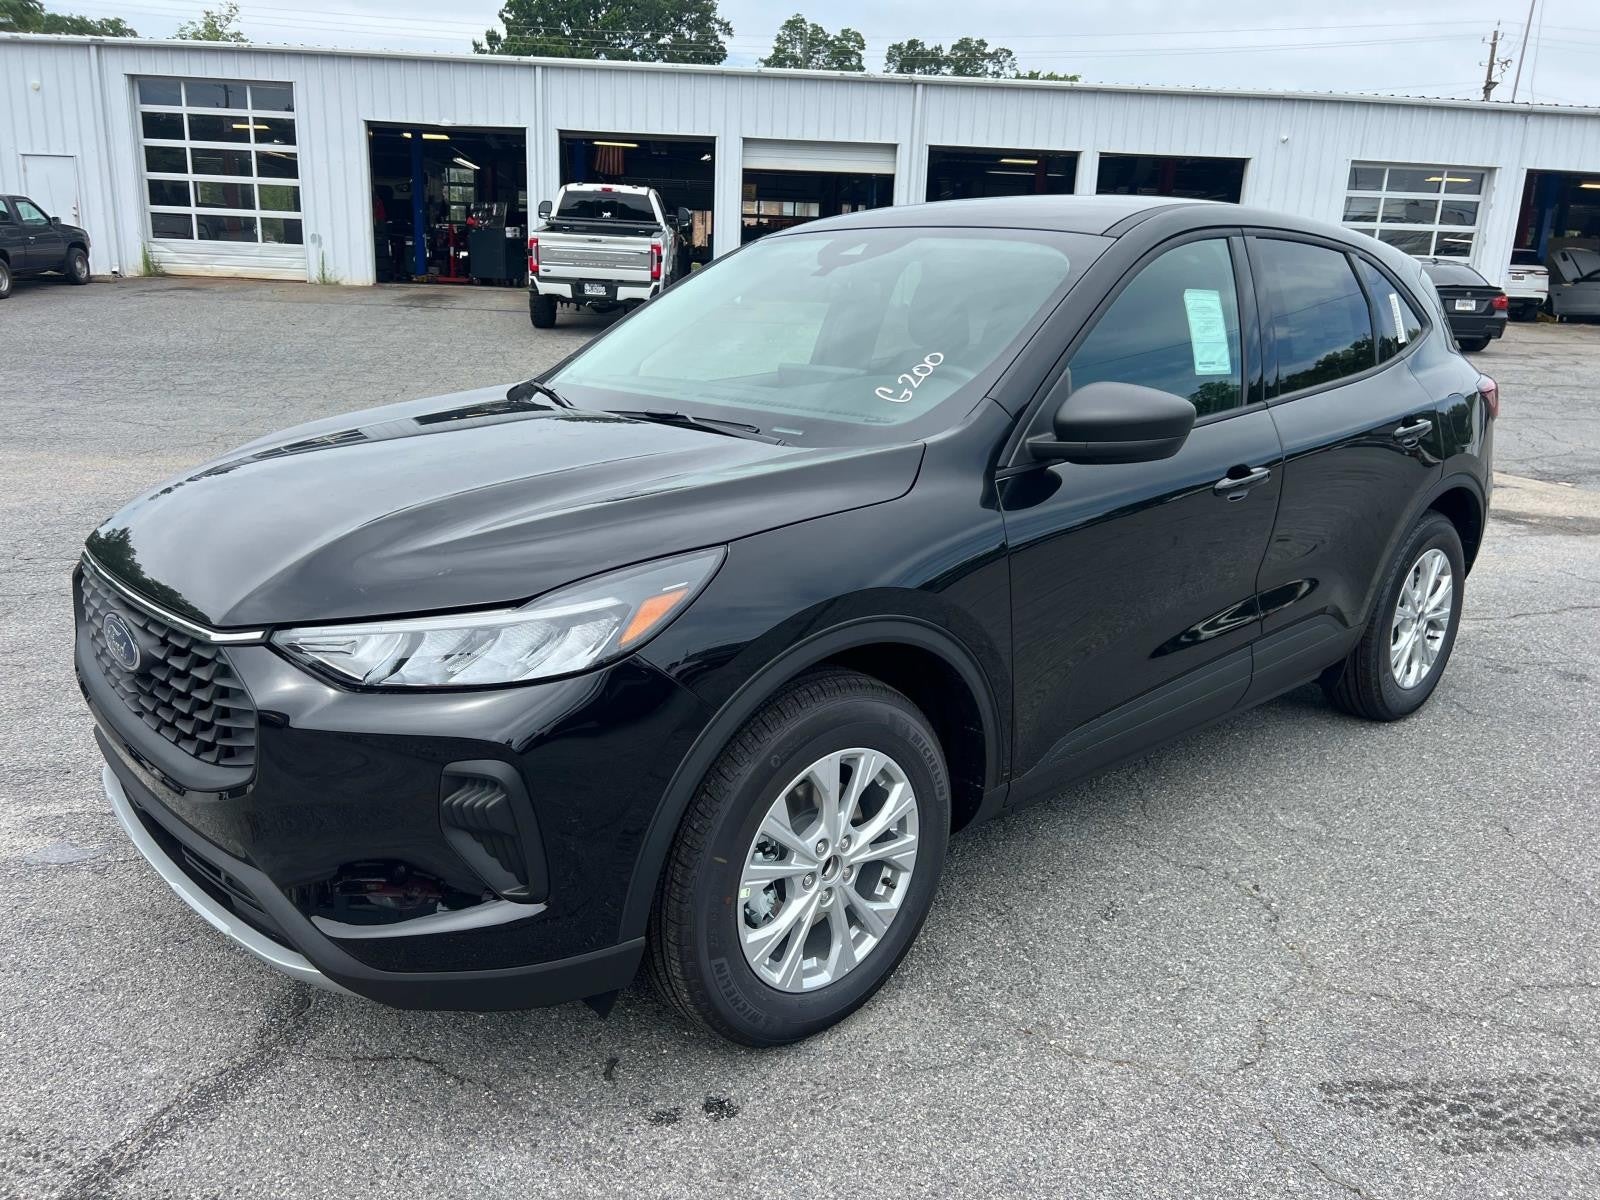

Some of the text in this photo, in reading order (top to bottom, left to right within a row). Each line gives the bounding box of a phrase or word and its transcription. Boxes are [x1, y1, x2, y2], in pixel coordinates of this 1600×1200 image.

[107, 624, 127, 660] Ford
[910, 732, 946, 798] MICHELIN
[714, 961, 763, 1024] MICHELIN
